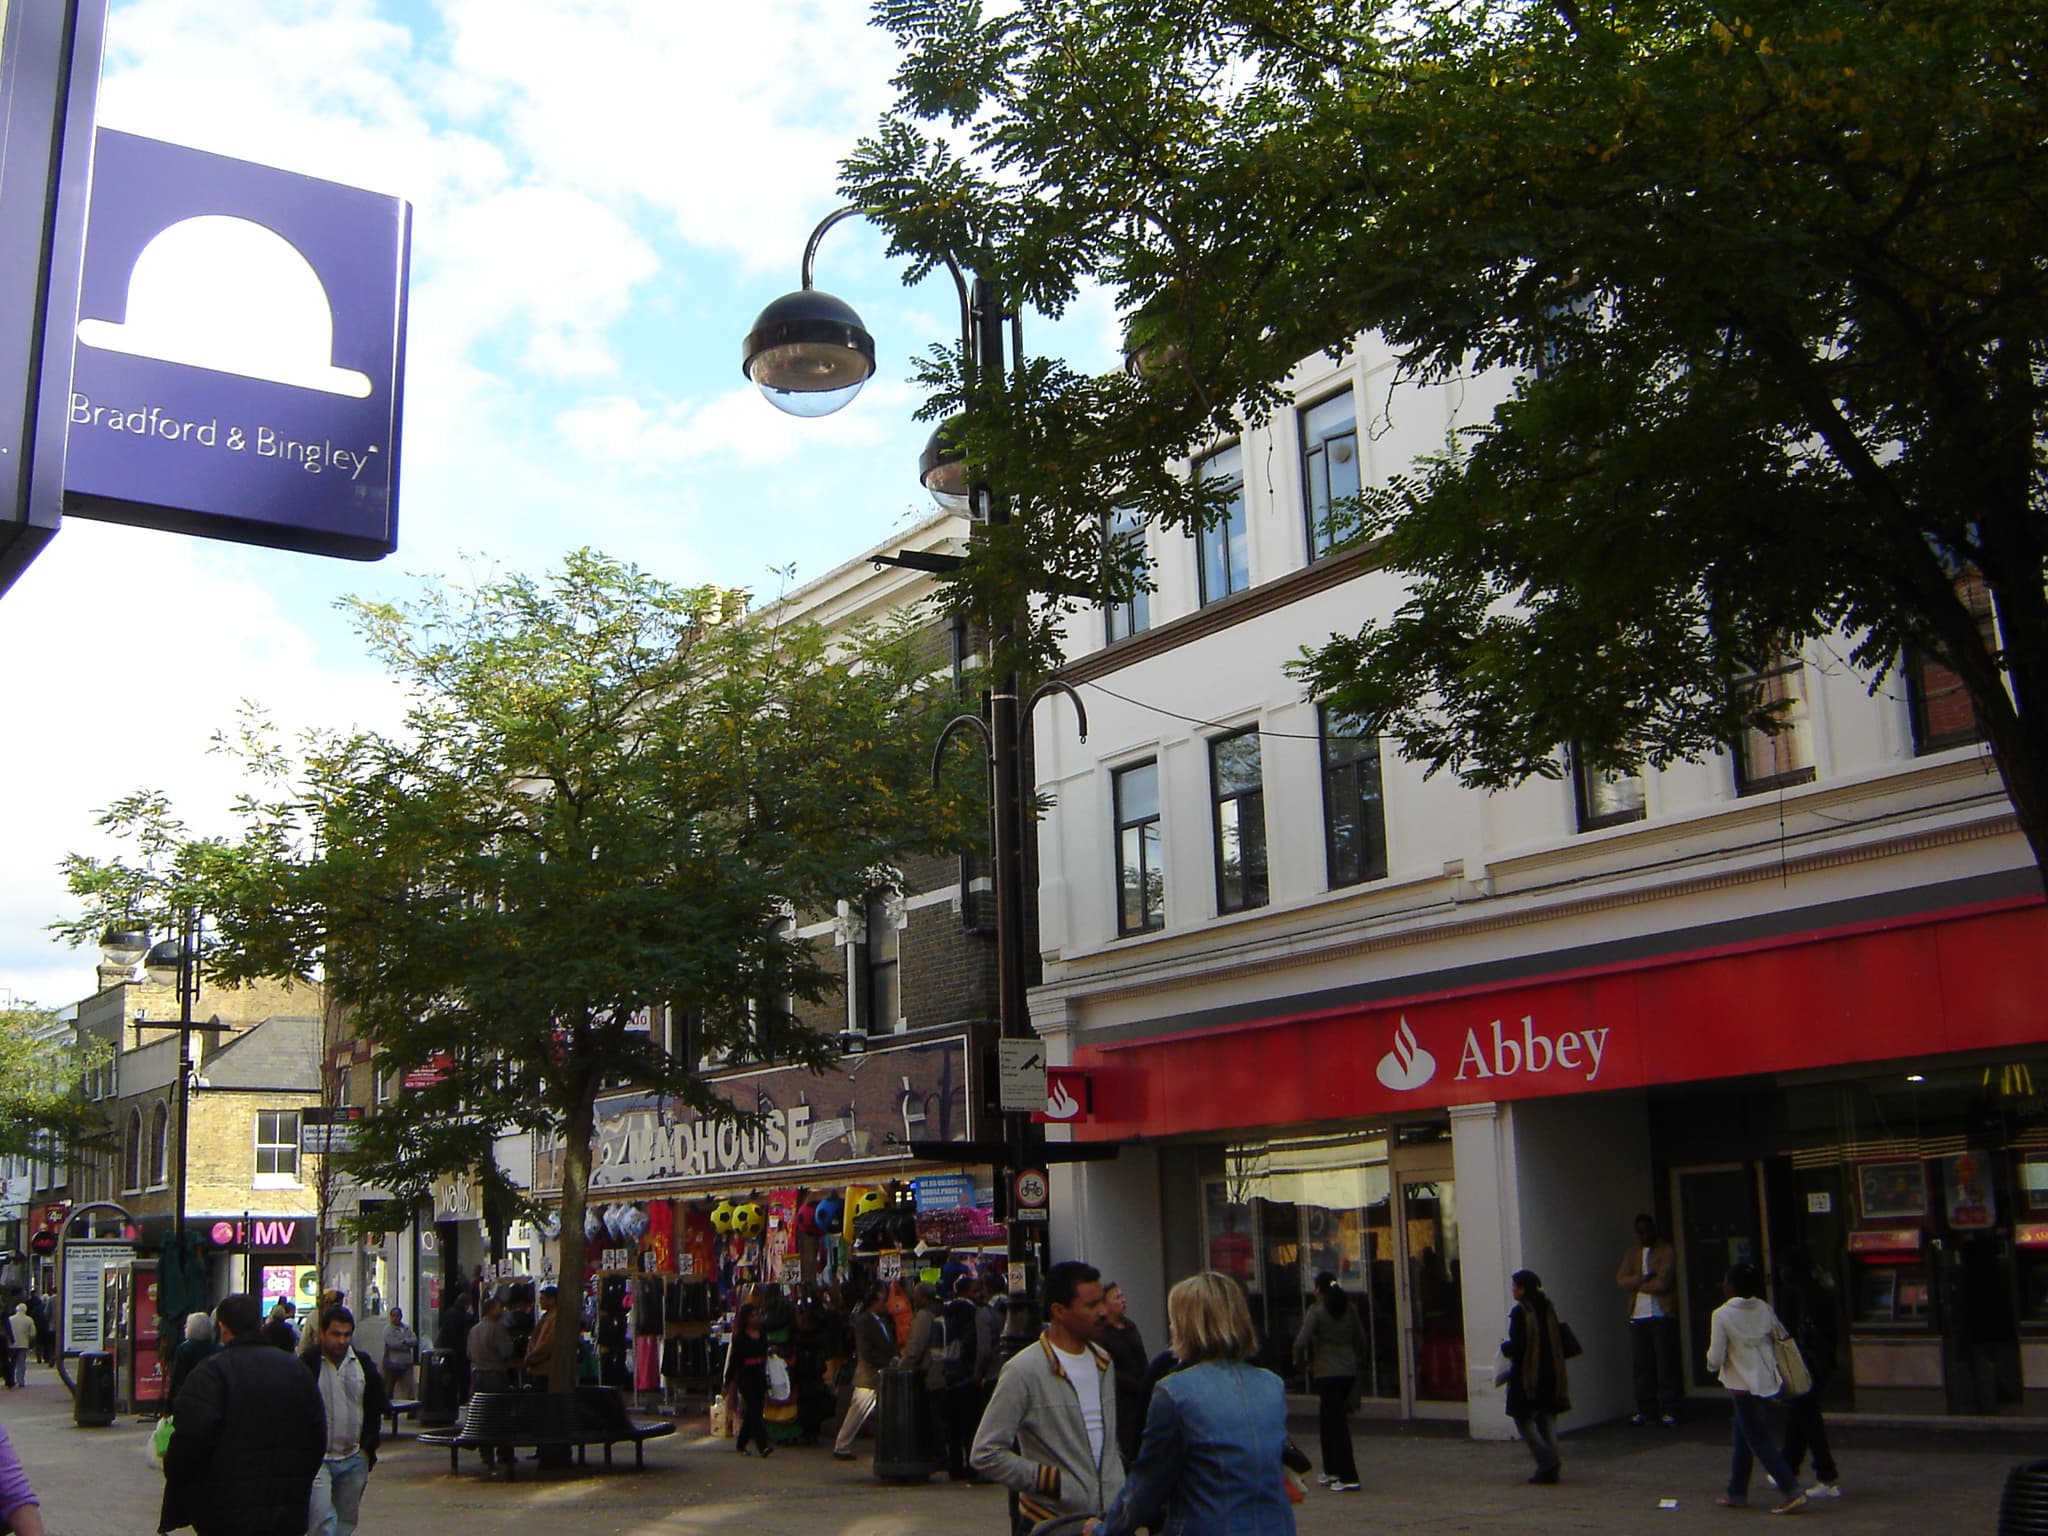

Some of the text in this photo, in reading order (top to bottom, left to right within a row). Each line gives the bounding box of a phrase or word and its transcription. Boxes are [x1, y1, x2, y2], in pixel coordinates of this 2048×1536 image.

[70, 393, 369, 480] Bradford & Bingley
[1454, 1016, 1610, 1082] Abbey
[627, 1106, 810, 1172] MADHOUSE
[441, 1173, 470, 1213] wallis
